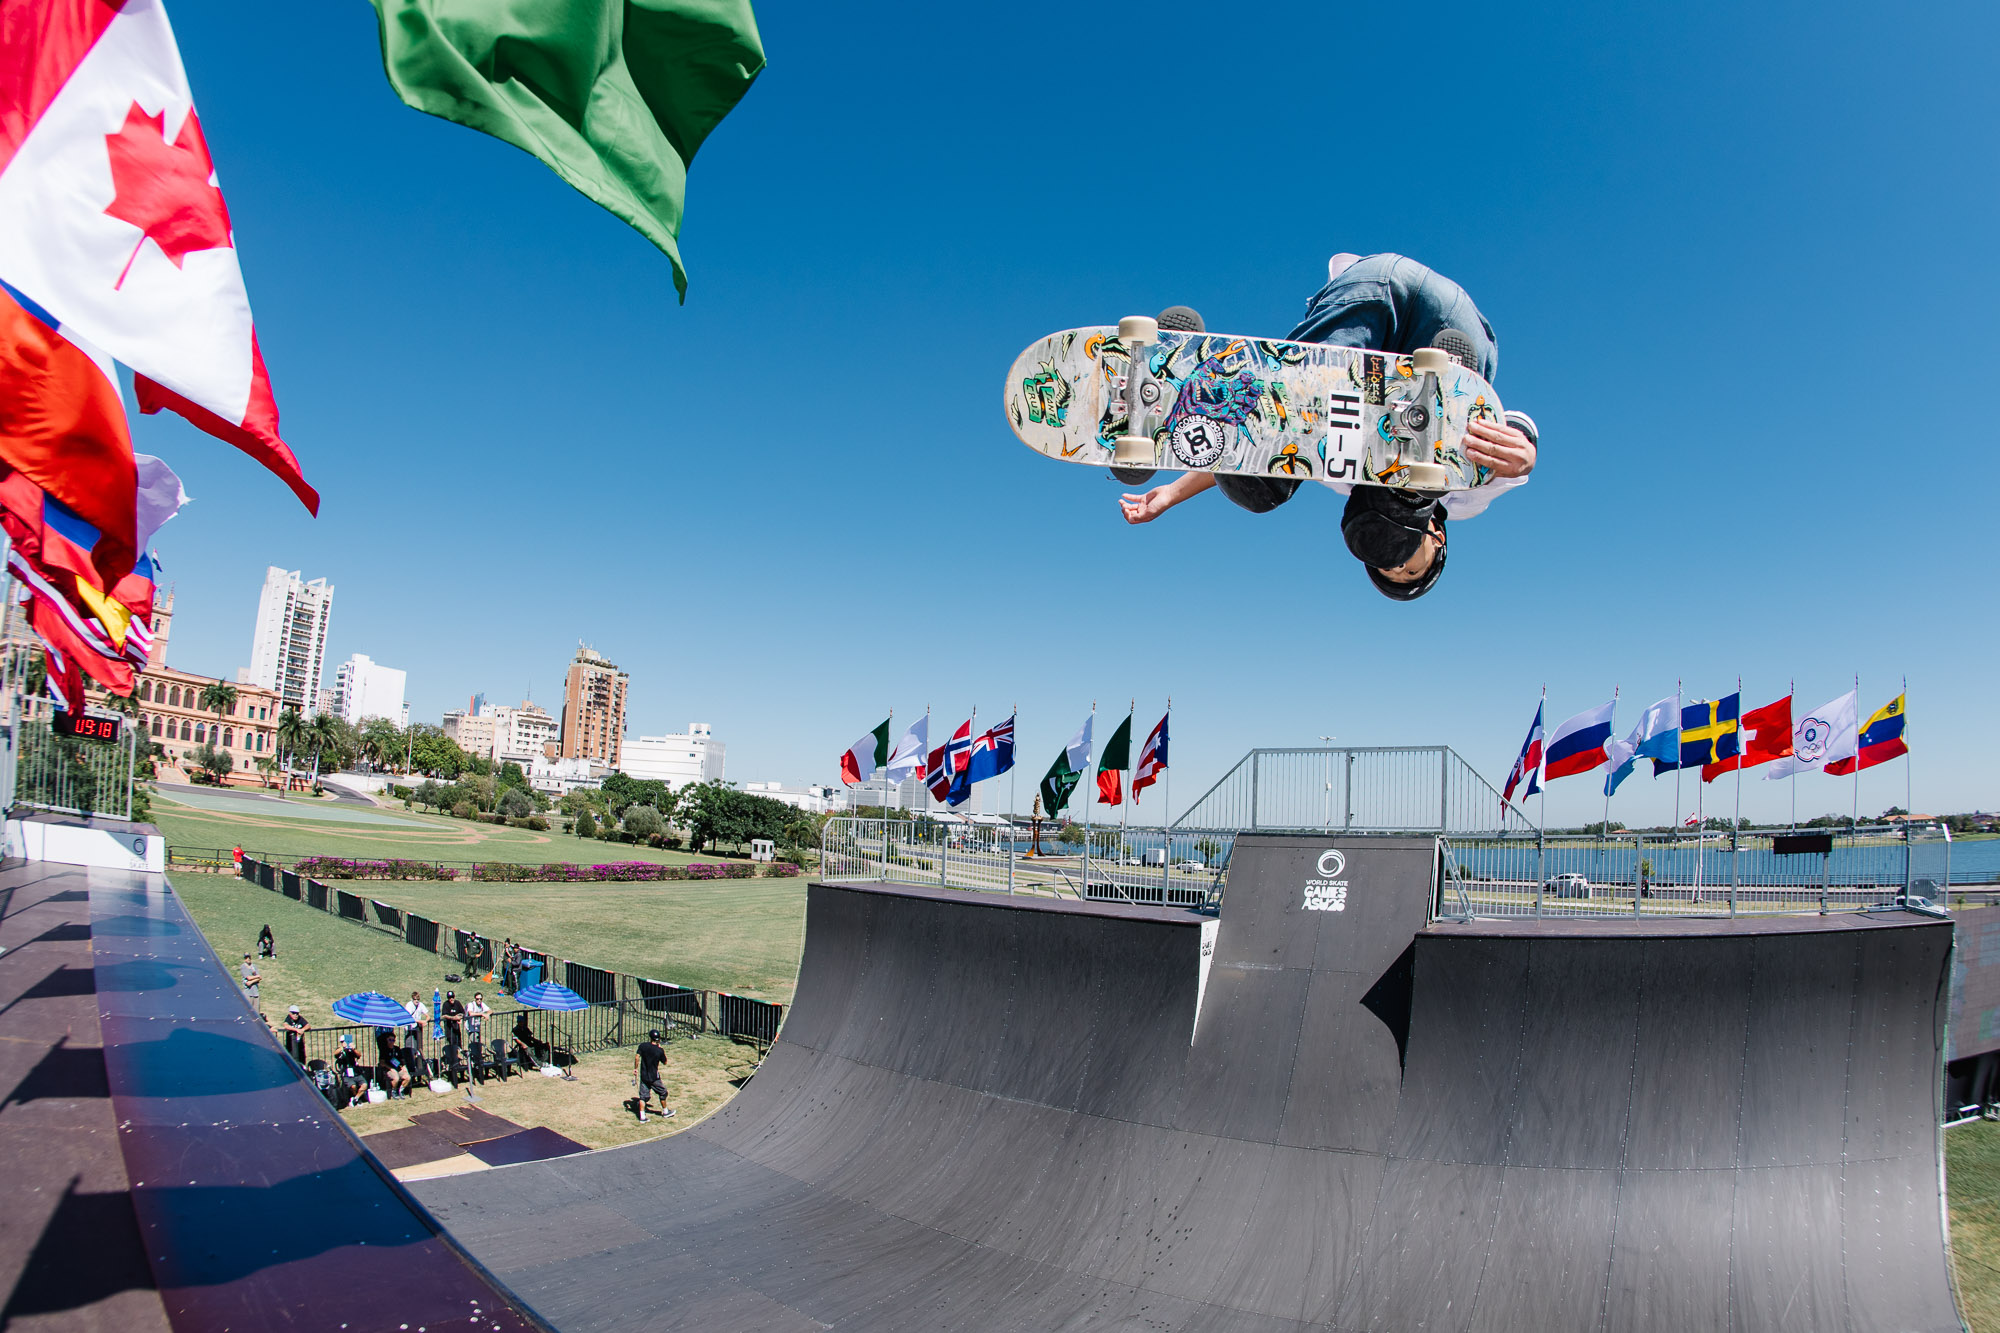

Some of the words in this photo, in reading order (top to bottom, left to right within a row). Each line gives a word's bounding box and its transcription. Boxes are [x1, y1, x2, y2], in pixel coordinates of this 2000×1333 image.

[1025, 384, 1040, 416] CRUZ
[1043, 388, 1058, 423] SANTA
[1327, 393, 1360, 480] Hi-5
[1303, 885, 1348, 899] GAMES
